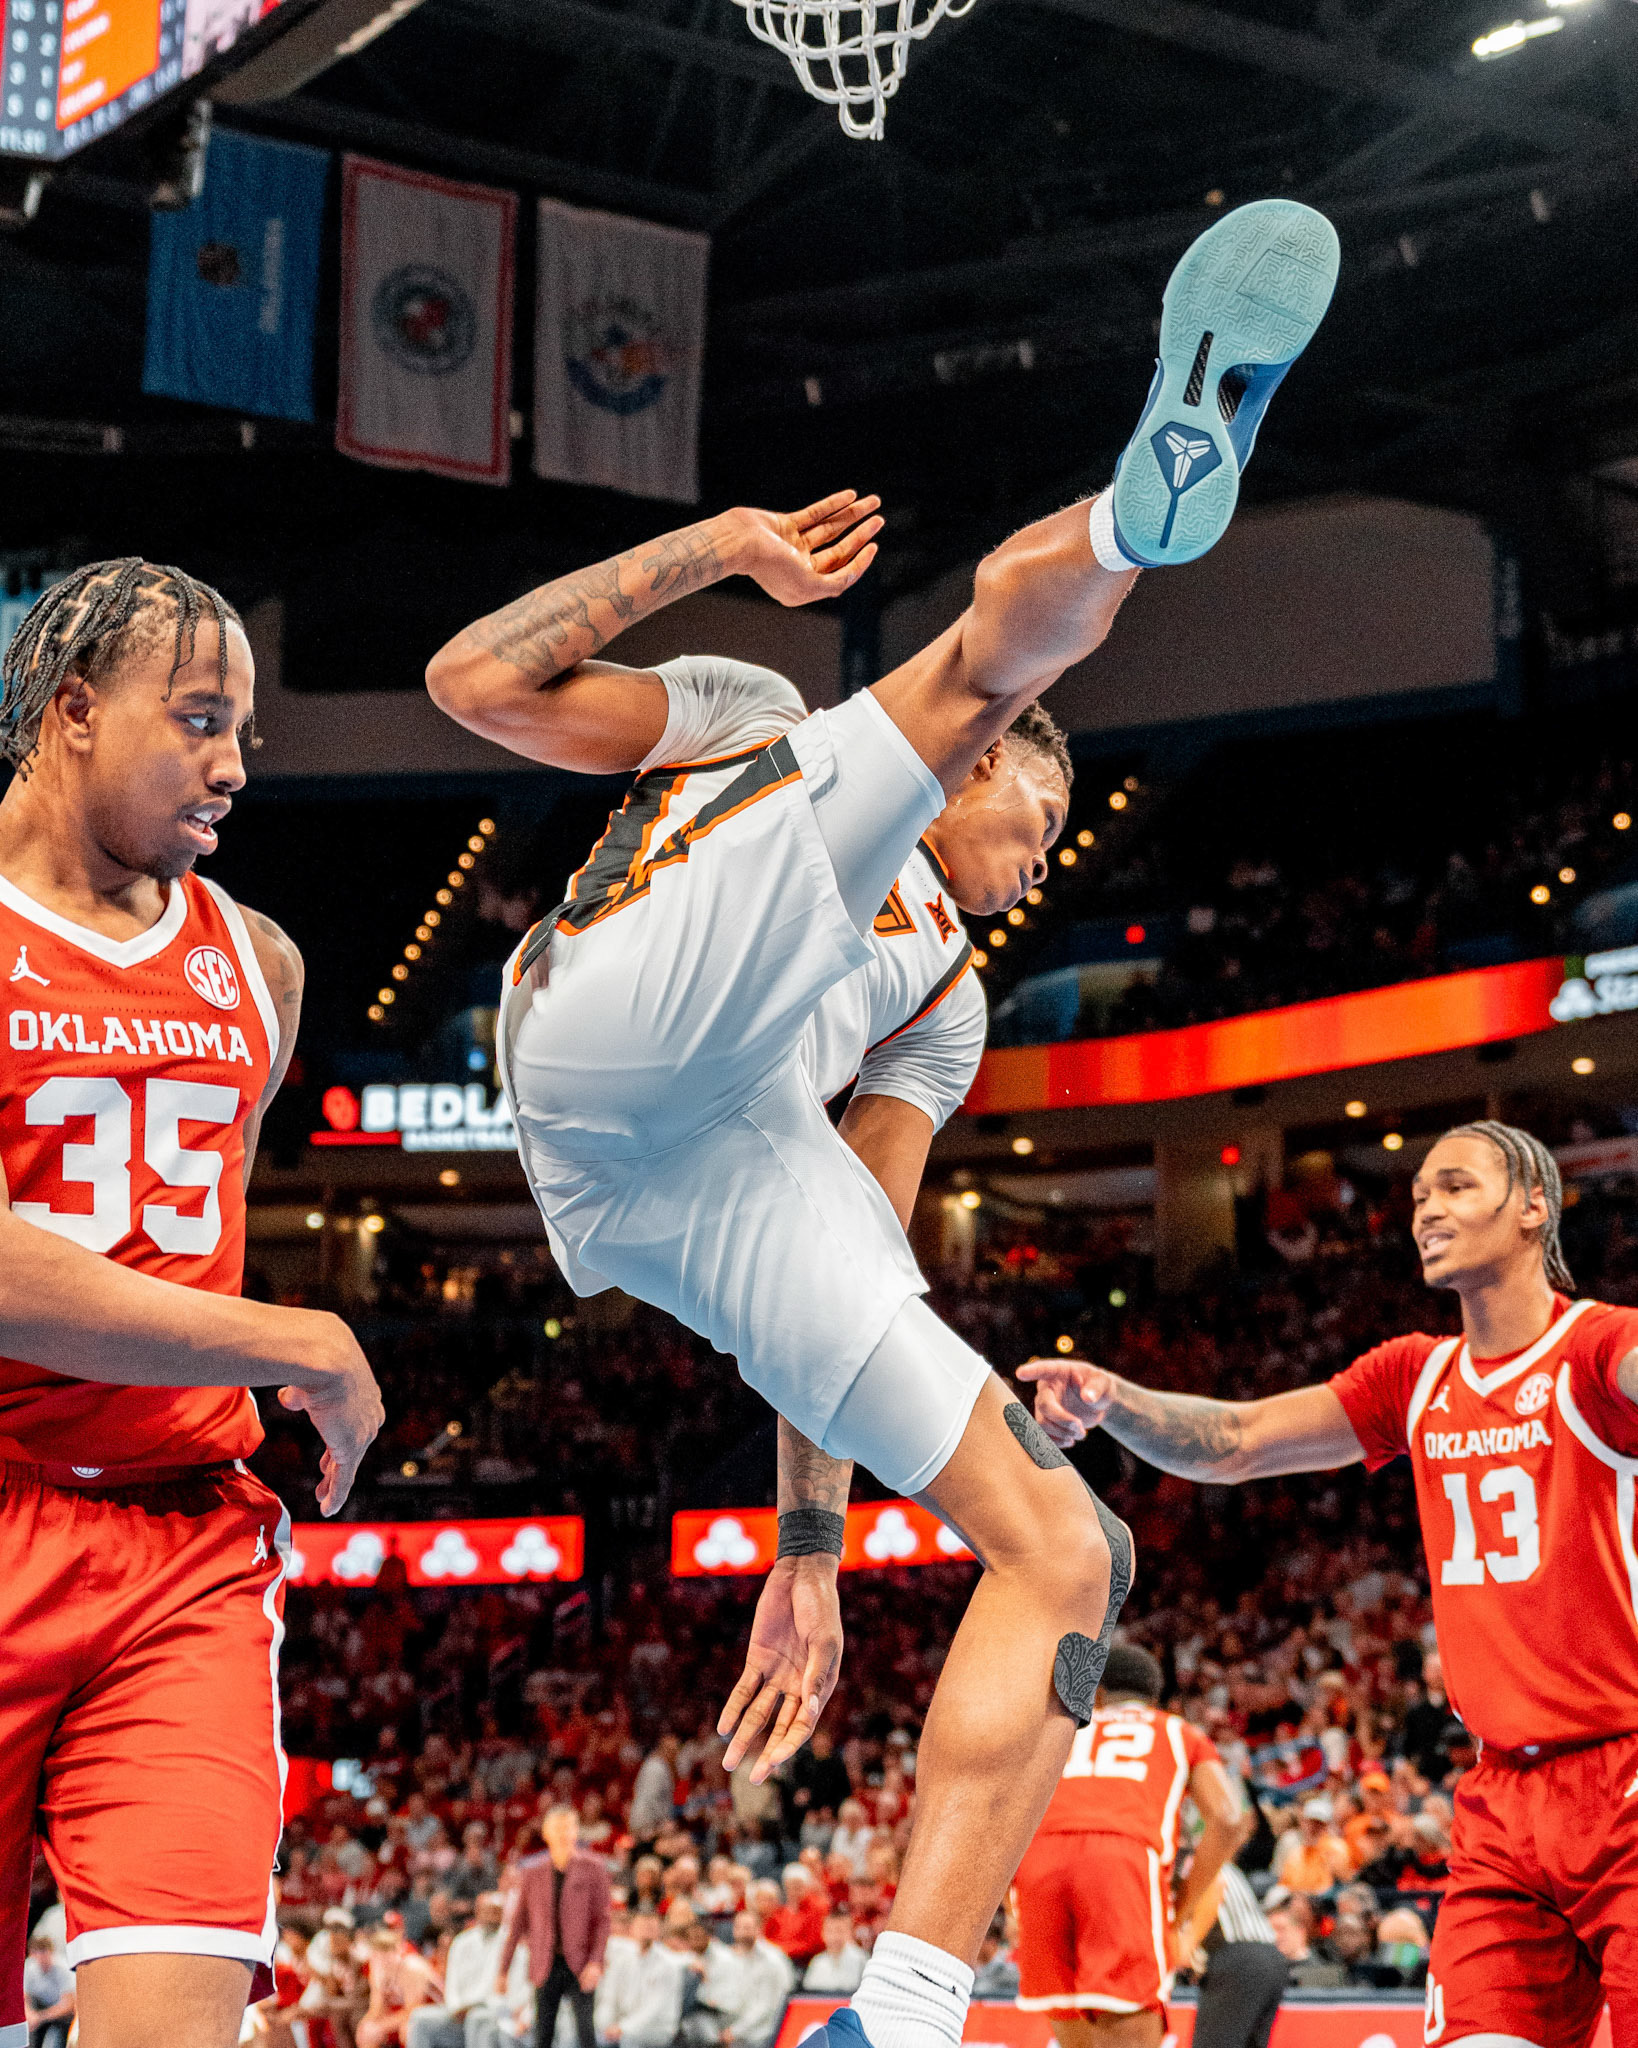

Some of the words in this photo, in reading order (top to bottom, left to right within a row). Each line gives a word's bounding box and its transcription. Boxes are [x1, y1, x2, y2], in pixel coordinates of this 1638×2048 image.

[188, 949, 238, 1006] SEC
[9, 1010, 253, 1066] OKLAHOMA
[11, 1077, 240, 1255] 35
[1517, 1374, 1552, 1413] SEC
[1424, 1419, 1552, 1459] OKLAHOMA
[1441, 1465, 1540, 1585] 13
[1062, 1721, 1154, 1782] 12
